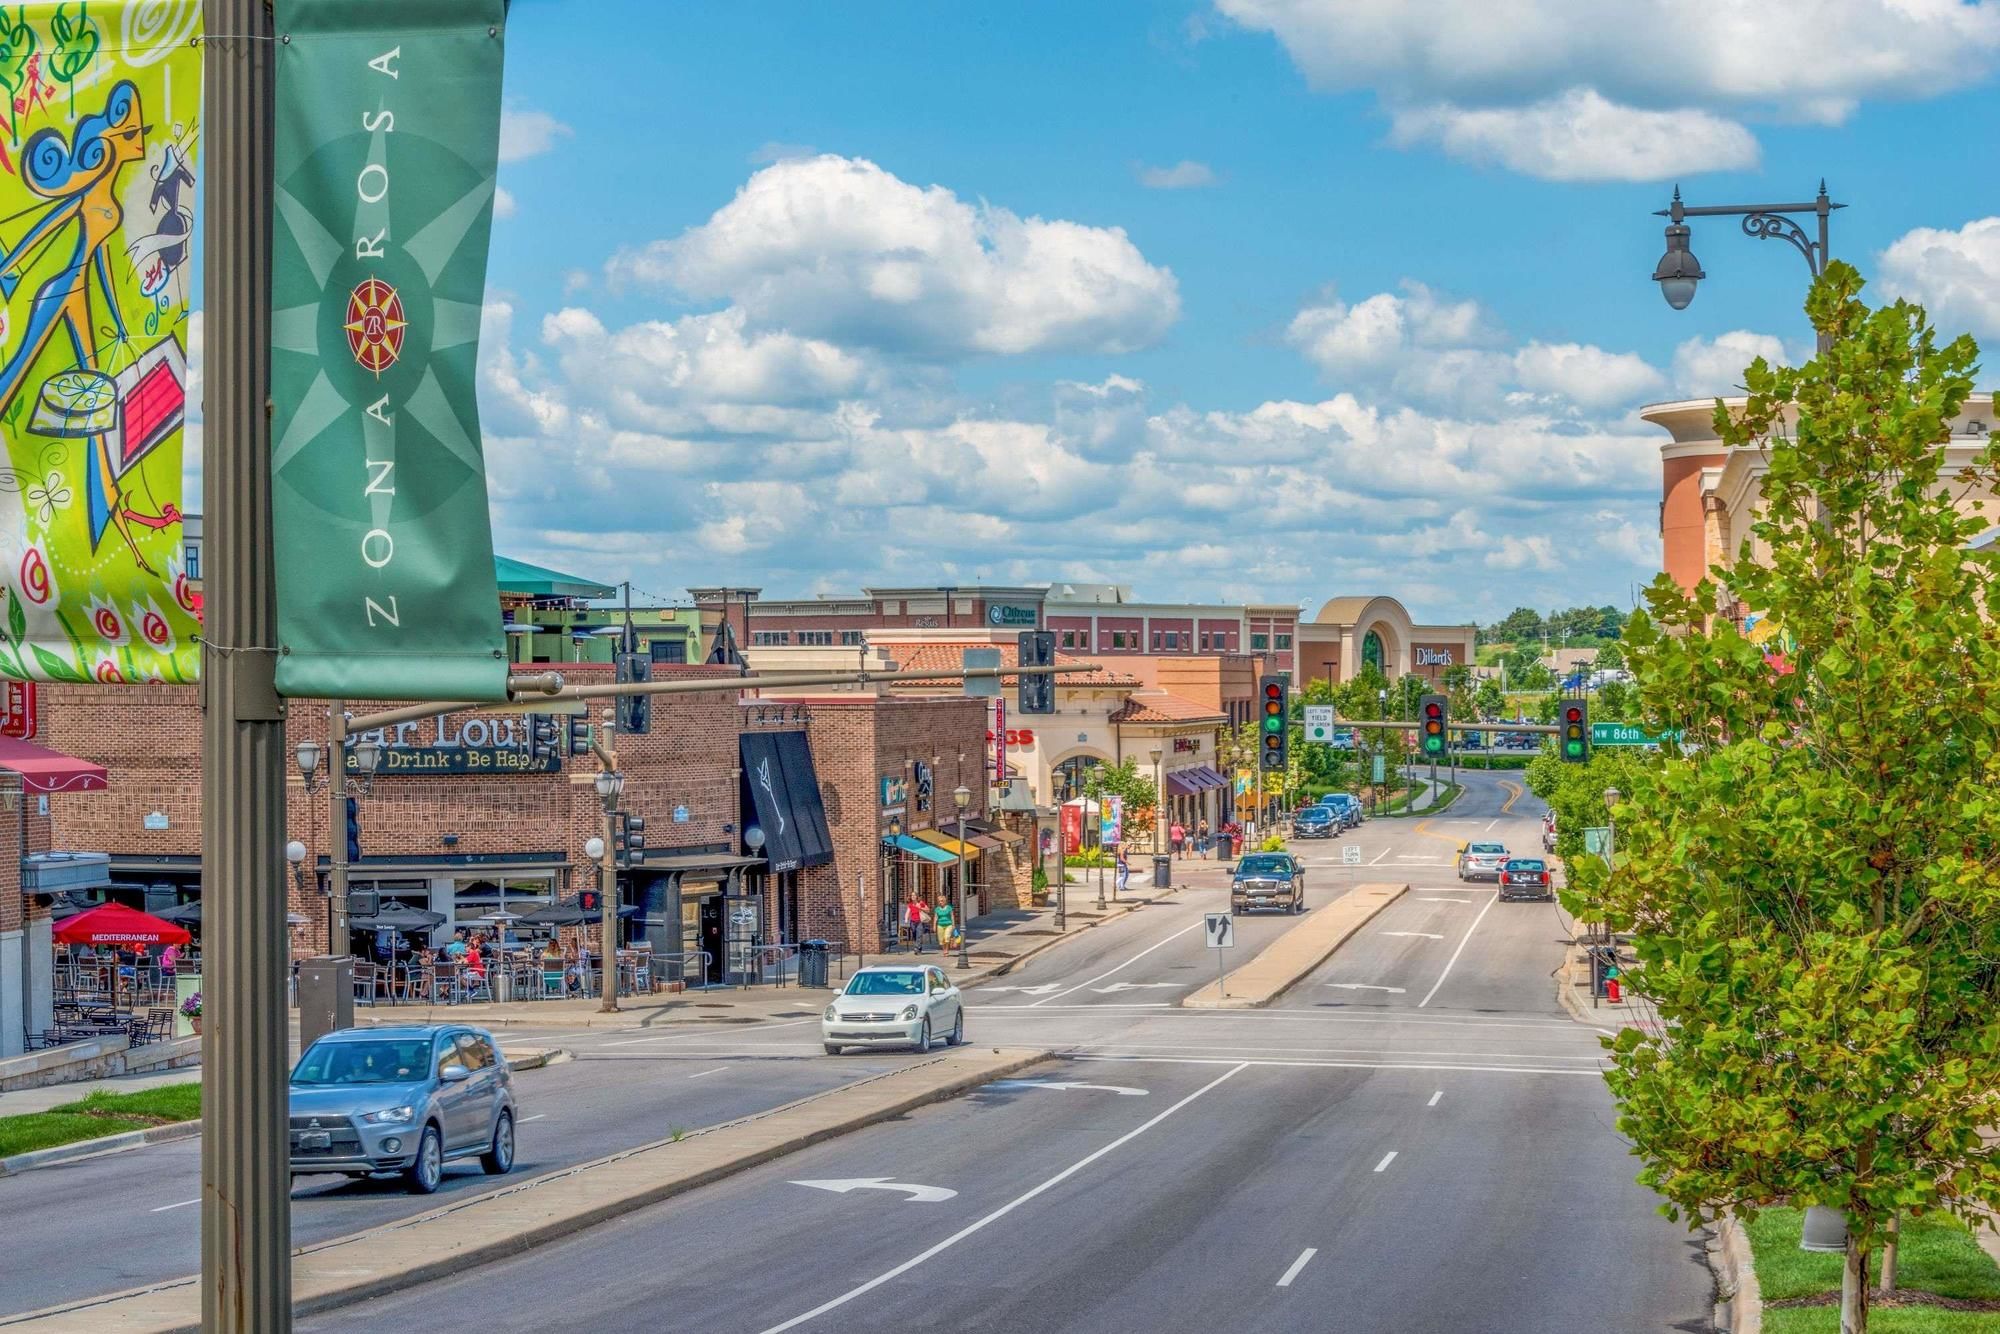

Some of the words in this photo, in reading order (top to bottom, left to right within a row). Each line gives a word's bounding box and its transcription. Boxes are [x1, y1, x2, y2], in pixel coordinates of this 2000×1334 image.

[356, 45, 401, 261] ROSA
[361, 392, 400, 627] ZONA
[1416, 647, 1452, 666] Dillard's
[1594, 729, 1608, 739] NW
[1613, 728, 1640, 740] 86th
[387, 751, 450, 768] Drink
[466, 751, 491, 768] Be
[91, 933, 160, 942] MEDITERRANEAN
